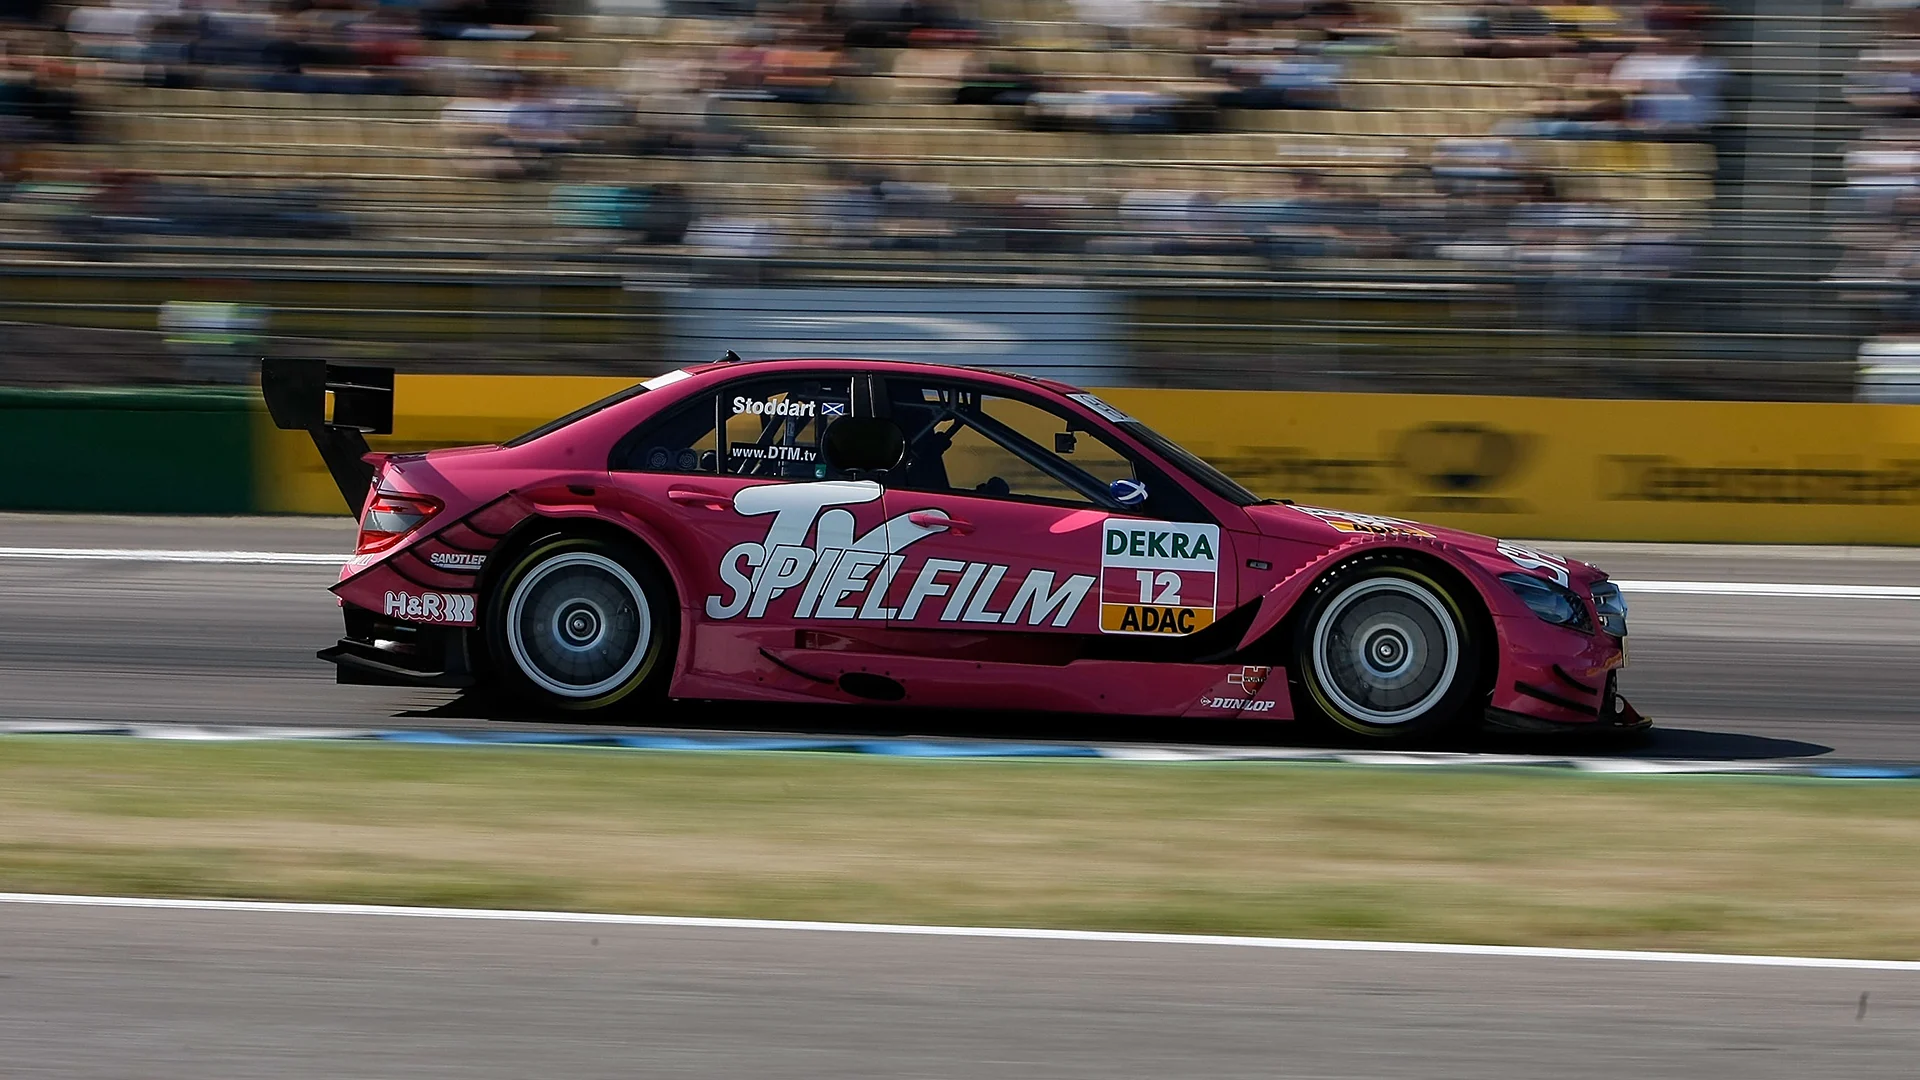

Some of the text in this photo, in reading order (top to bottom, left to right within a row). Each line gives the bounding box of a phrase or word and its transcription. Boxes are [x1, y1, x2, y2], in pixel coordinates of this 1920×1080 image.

[732, 396, 816, 417] Stoddart
[732, 446, 817, 461] www.DTM.tv
[1105, 529, 1214, 560] DEKRA
[706, 542, 1097, 627] SPIELFILM
[1136, 570, 1182, 605] 12
[385, 591, 443, 620] H&R
[1120, 606, 1195, 634] ADAC
[1210, 697, 1276, 711] DUNLOP
